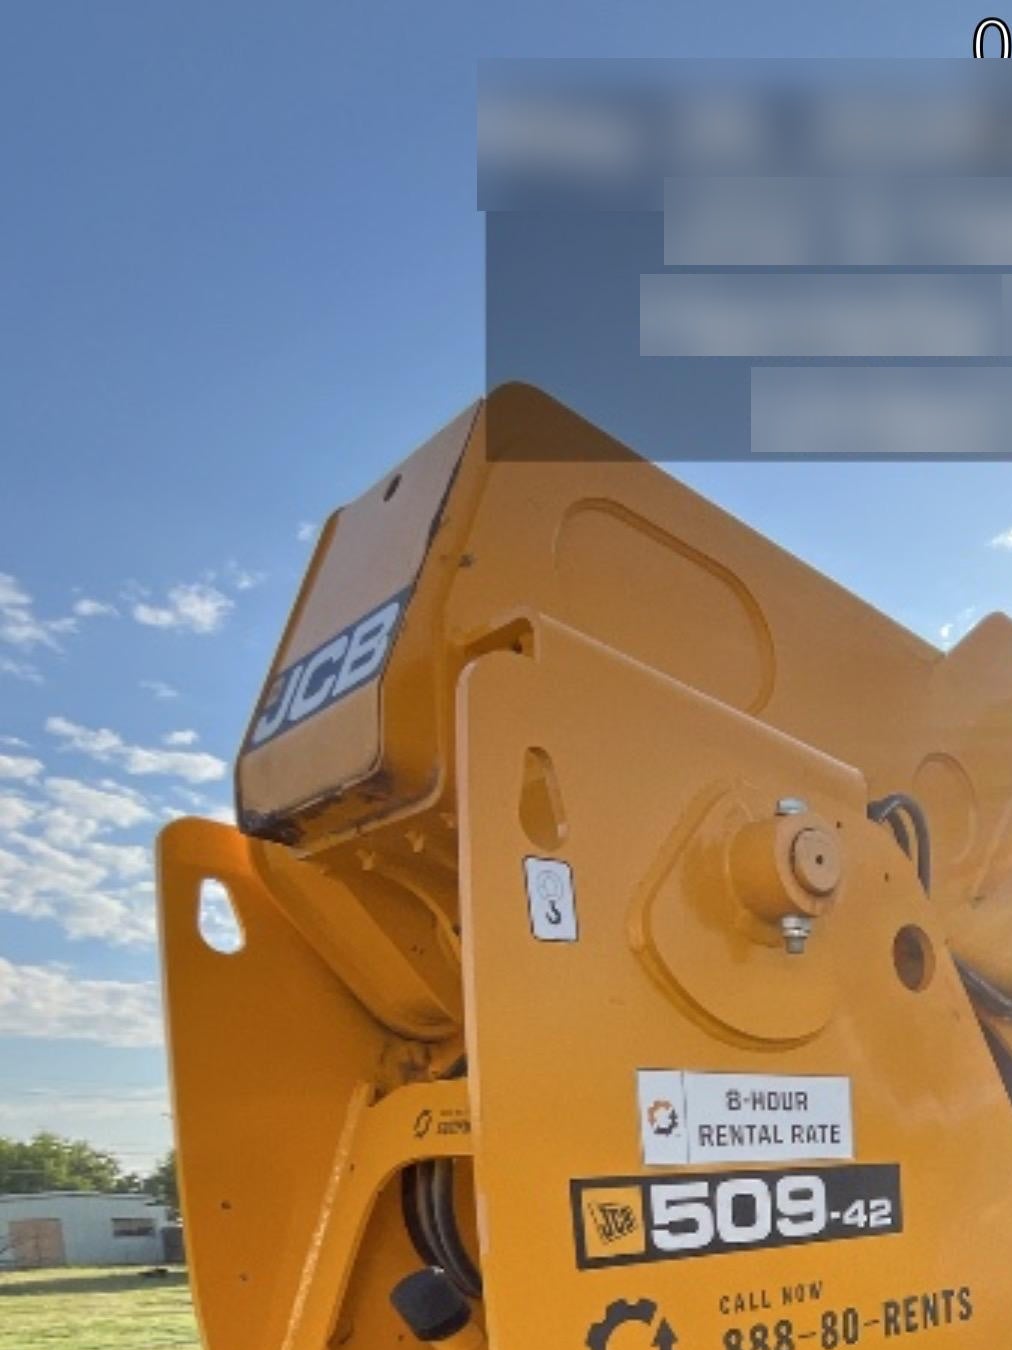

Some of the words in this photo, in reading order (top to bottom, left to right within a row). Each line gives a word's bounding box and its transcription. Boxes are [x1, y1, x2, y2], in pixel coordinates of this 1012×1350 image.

[252, 601, 400, 745] JCB
[725, 1090, 809, 1112] 8-HOUR
[699, 1124, 784, 1147] RENTAL
[790, 1123, 842, 1145] RATE
[649, 1174, 893, 1253] 509-42
[719, 1288, 772, 1316] CALL
[782, 1280, 824, 1306] NOW
